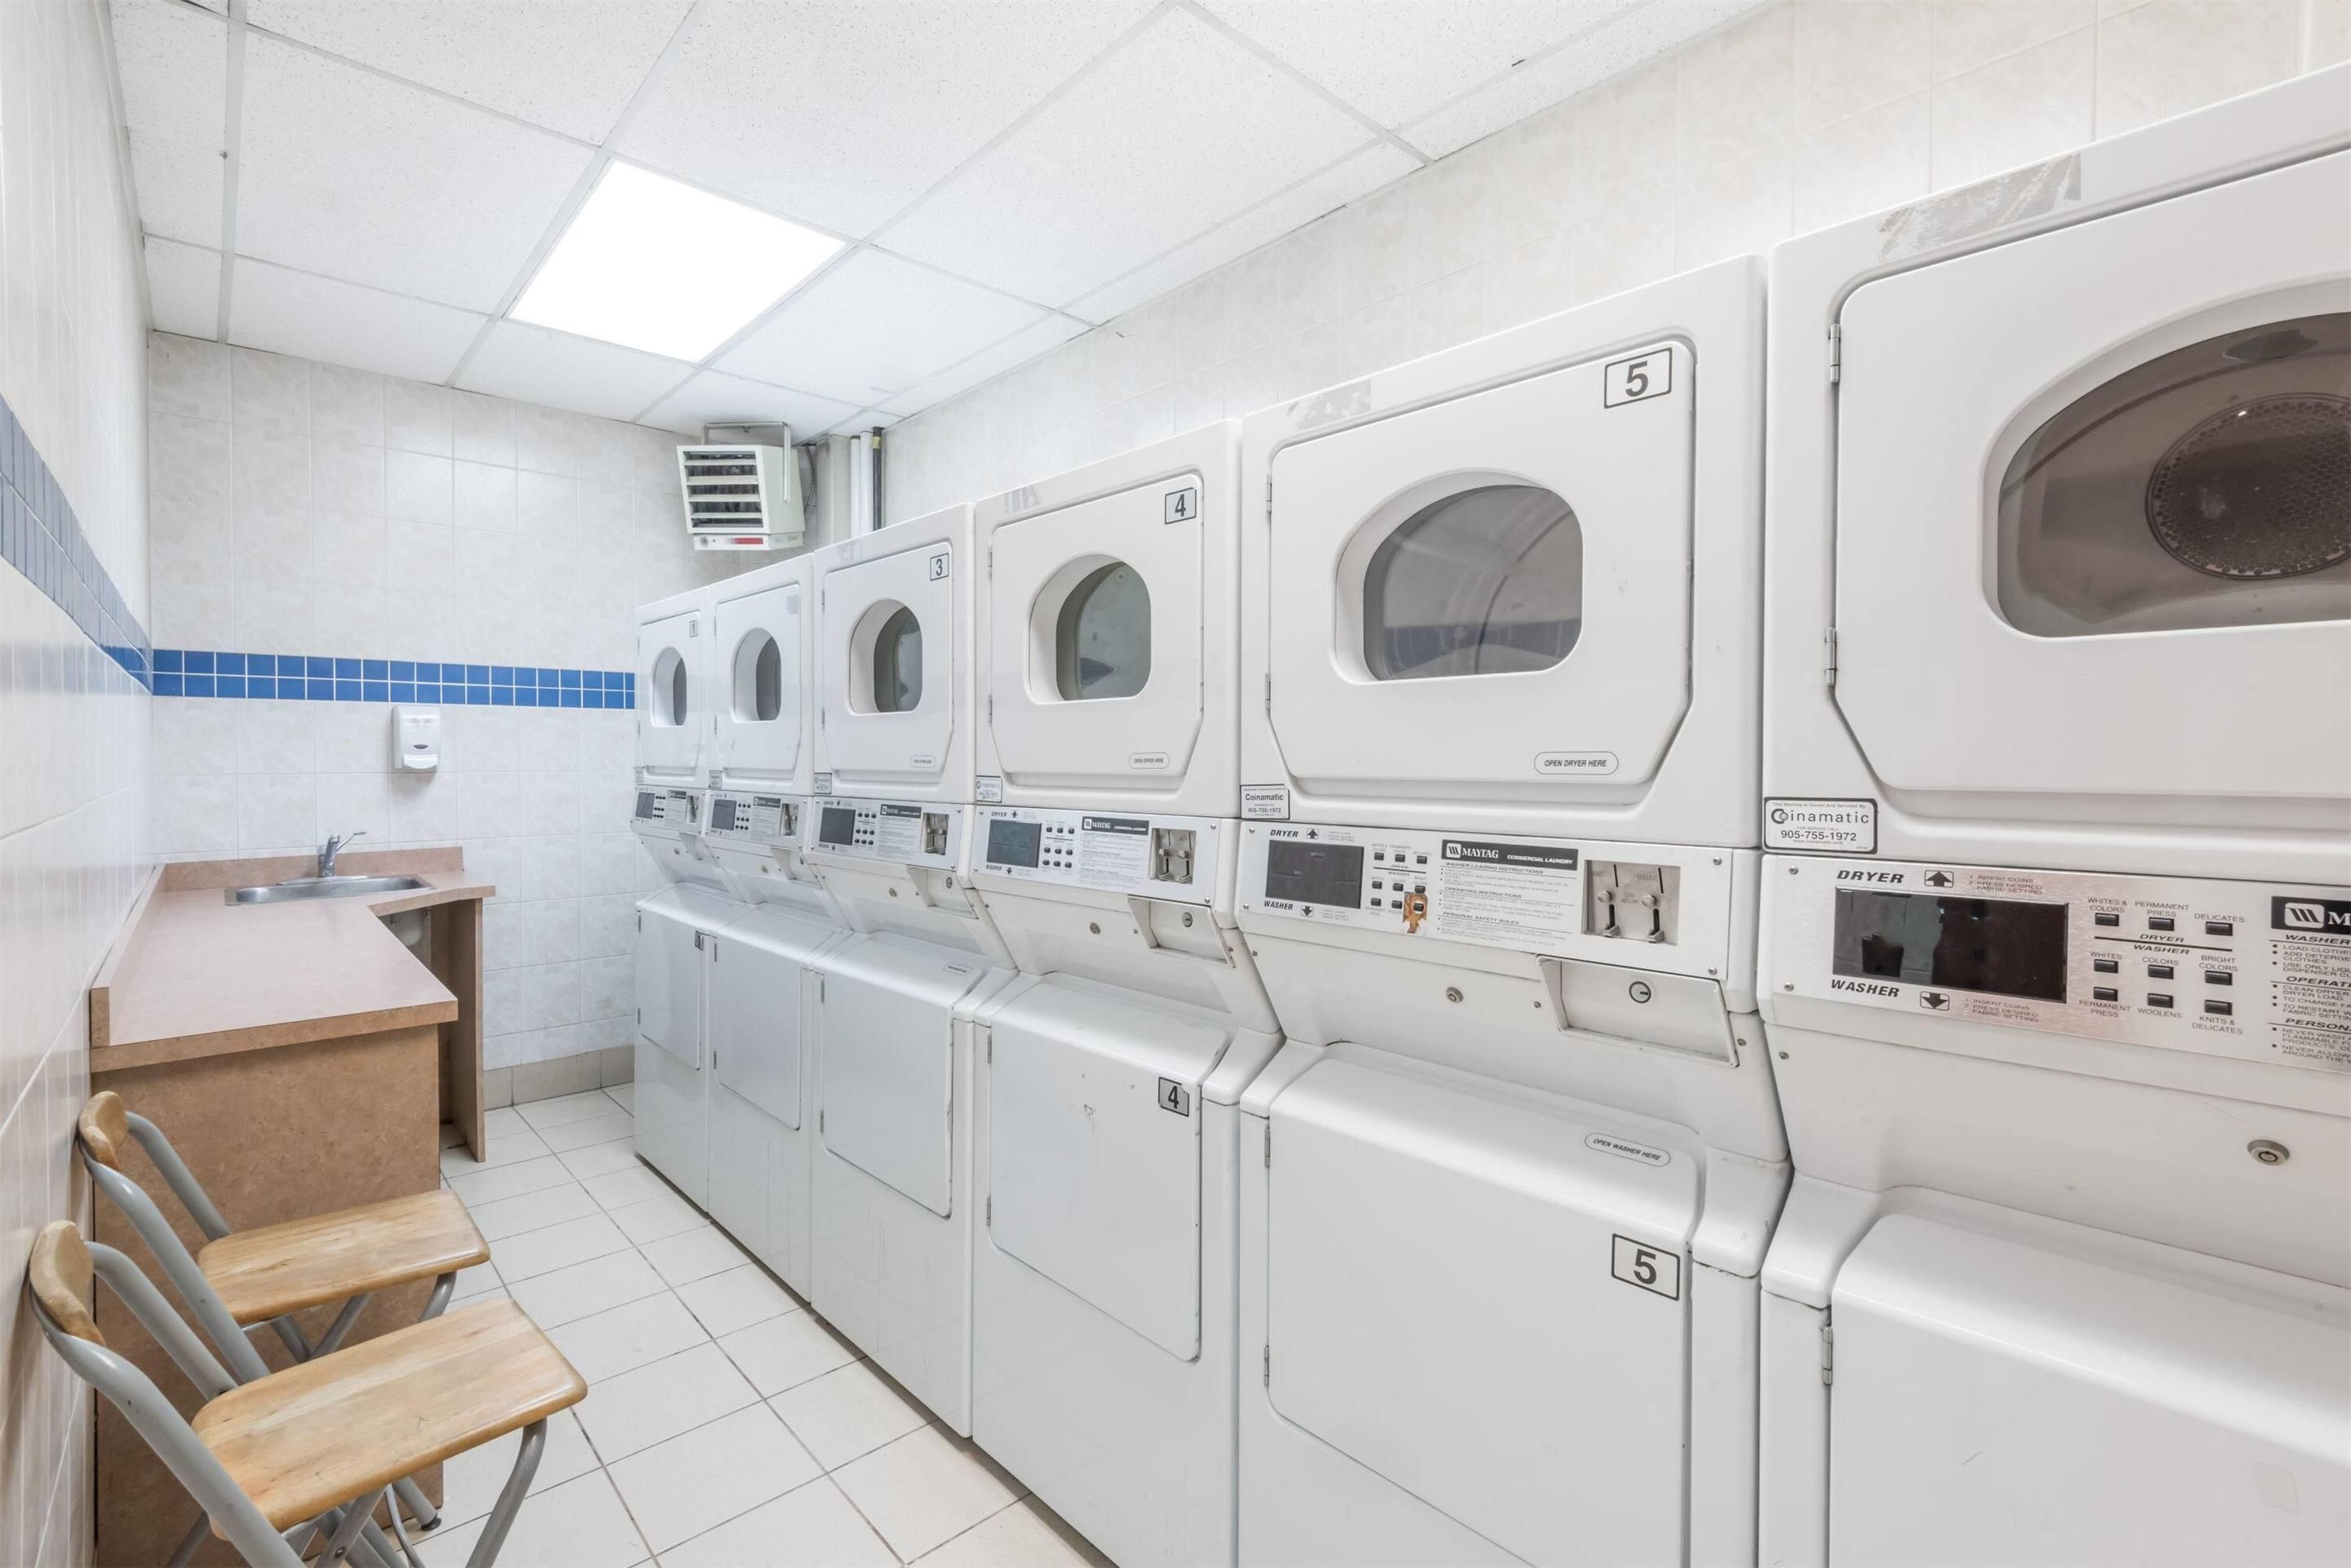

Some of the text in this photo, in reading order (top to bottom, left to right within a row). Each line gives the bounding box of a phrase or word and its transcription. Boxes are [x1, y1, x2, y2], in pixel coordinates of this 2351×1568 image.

[1625, 360, 1649, 398] 5
[1175, 493, 1186, 517] 4
[936, 557, 943, 576] 3
[1544, 759, 1607, 767] OPEN DRYER HERE
[1245, 793, 1284, 801] Coinamatic
[1269, 829, 1299, 837] DRYER
[1781, 829, 1857, 842] 905-755-1972
[1461, 848, 1500, 859] MAYTAG
[1507, 855, 1544, 863] COMMERCIAL
[1498, 866, 1544, 874] INSTRUCTIONS
[1837, 869, 1904, 884] DRYER
[1444, 886, 1522, 899] OPERATING INSTRUCTIONS
[1264, 900, 1294, 911] WASHER
[2087, 898, 2120, 906] WHITES
[2135, 901, 2189, 910] PERMANENT
[2090, 905, 2125, 913] COLORS
[2147, 908, 2176, 917] PRESS
[2194, 913, 2245, 922] DELICATES
[2140, 934, 2184, 943] DRYER
[2286, 935, 2351, 945] WASHER
[2134, 944, 2189, 954] WASHER
[2090, 951, 2122, 960] WHITES
[2201, 955, 2236, 964] BRIGHT
[2283, 956, 2327, 964] CLOTHES
[2142, 957, 2180, 966] COLORS
[2198, 962, 2238, 971] COLORS
[2283, 967, 2337, 976] DISPENSER
[1831, 979, 1900, 997] WASHER
[1973, 998, 2002, 1006] INSERT
[2079, 1000, 2131, 1012] PERMANENT
[2298, 998, 2337, 1006] CHANGE
[1972, 1004, 1999, 1012] PRESS
[2002, 1008, 2038, 1018] DESIRED
[2091, 1009, 2119, 1018] PRESS
[2137, 1007, 2182, 1019] WOOLENS
[2282, 1008, 2315, 1016] FABRIC
[2298, 1006, 2340, 1014] RESTART
[1972, 1009, 2039, 1023] FABRIC SETTING
[2199, 1015, 2227, 1025] KNITS
[2192, 1022, 2243, 1035] DELICATES
[2286, 1018, 2351, 1031] PERSON
[2282, 1028, 2314, 1036] NEVER
[2282, 1033, 2338, 1044] FLAMMABLE
[2282, 1038, 2335, 1049] PRODUCTS
[2282, 1045, 2350, 1058] NEVER ALLOW
[2282, 1050, 2322, 1059] AROUND
[1168, 1086, 1180, 1109] 4
[1593, 1138, 1662, 1161] OPEN WASHER HERE
[1633, 1248, 1657, 1285] 5
